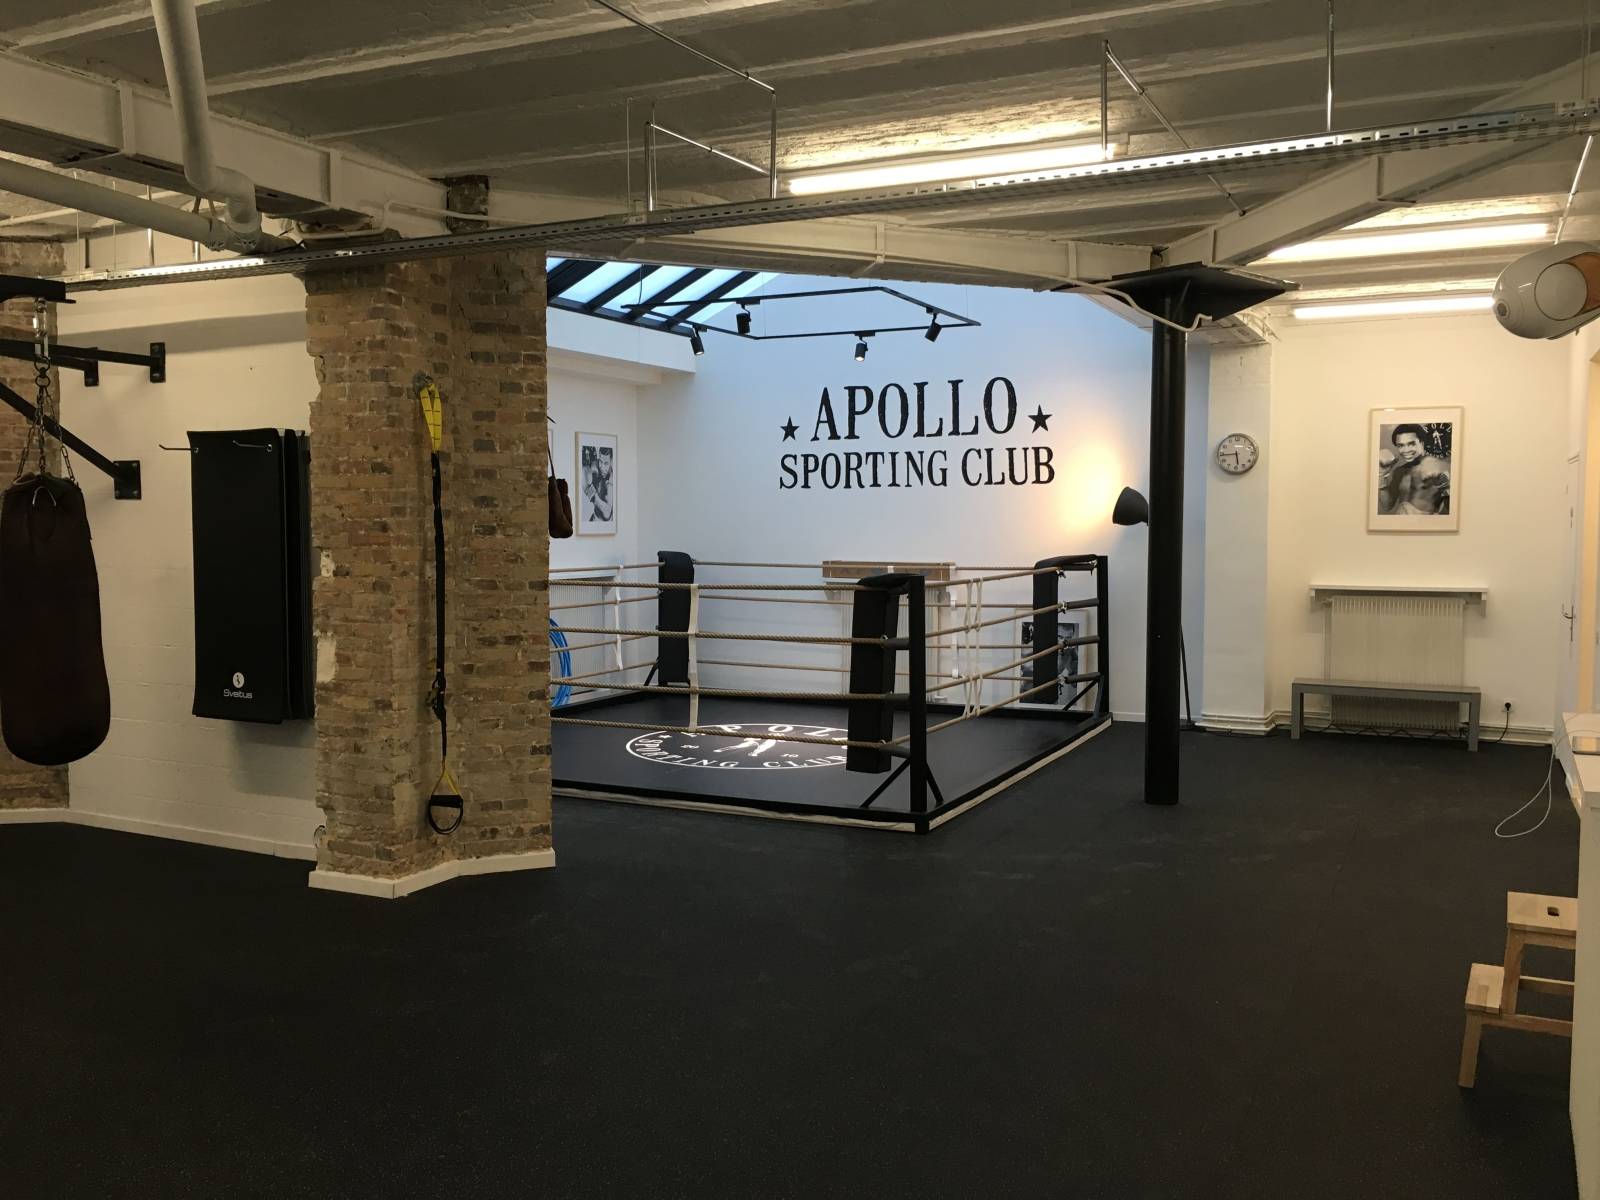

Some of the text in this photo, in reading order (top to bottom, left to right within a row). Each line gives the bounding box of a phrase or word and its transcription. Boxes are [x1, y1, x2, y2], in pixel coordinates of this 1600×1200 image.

[811, 377, 1017, 441] APOLLO
[780, 446, 1055, 490] SPORTING CLUB
[634, 738, 740, 768] SPORTING
